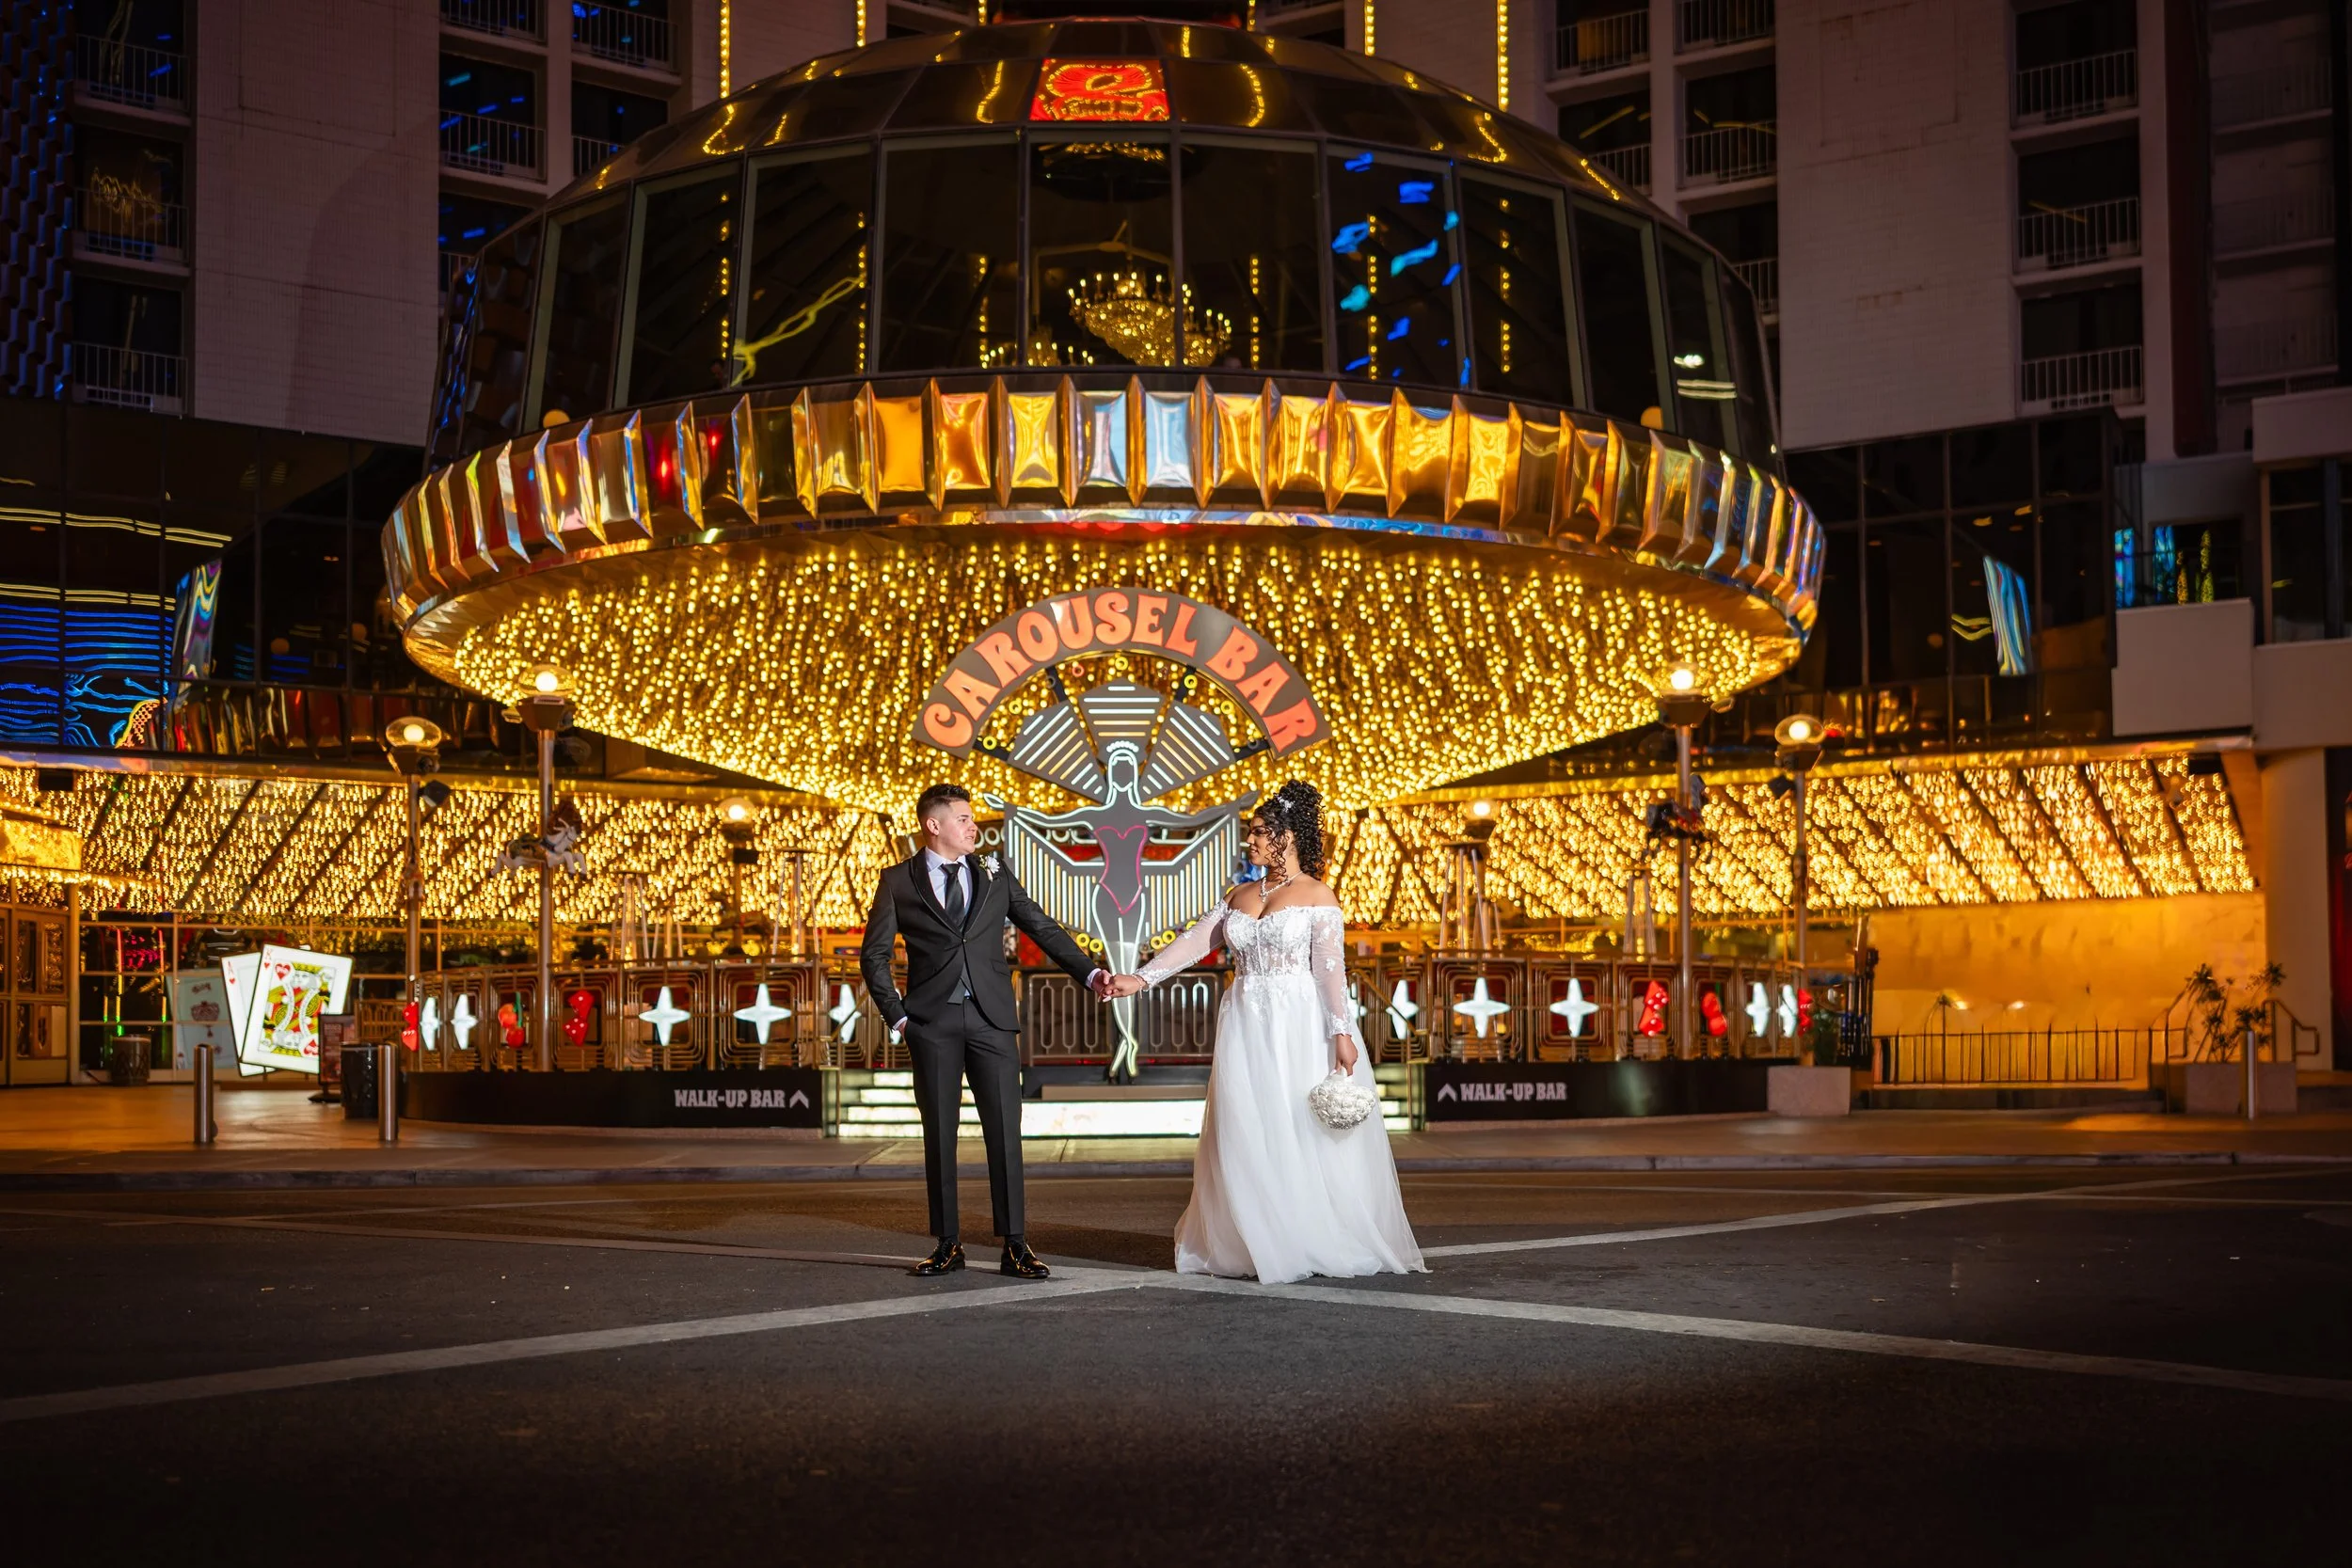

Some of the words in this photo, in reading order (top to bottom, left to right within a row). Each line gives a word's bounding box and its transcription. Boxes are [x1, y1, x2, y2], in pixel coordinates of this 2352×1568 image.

[923, 591, 1198, 748] CAROUSEL
[1205, 625, 1317, 752] BAR
[674, 1089, 748, 1108] WALK-UP
[750, 1089, 786, 1108] BAR
[1459, 1083, 1534, 1101] WALK-UP
[1535, 1082, 1566, 1101] BAR
